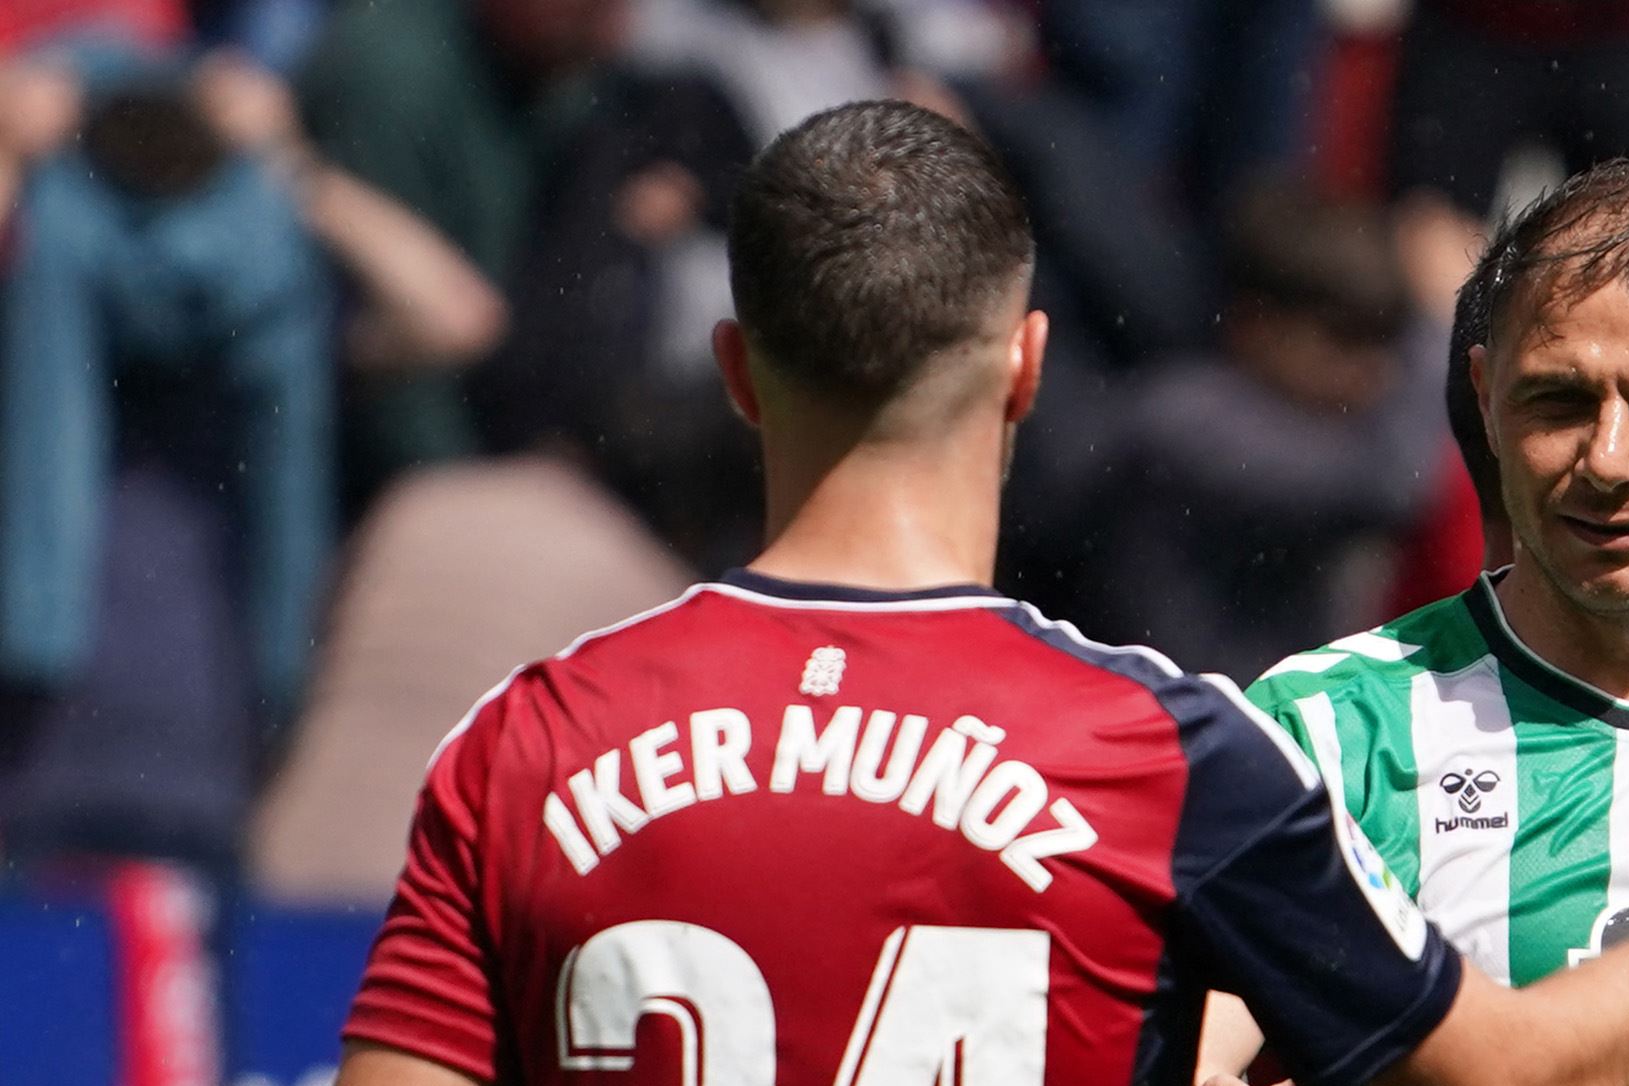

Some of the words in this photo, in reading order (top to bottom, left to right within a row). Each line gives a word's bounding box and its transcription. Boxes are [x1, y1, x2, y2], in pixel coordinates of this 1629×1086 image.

[543, 707, 758, 876] IKER
[768, 704, 1099, 894] MUÑOZ
[1434, 811, 1509, 835] hummel
